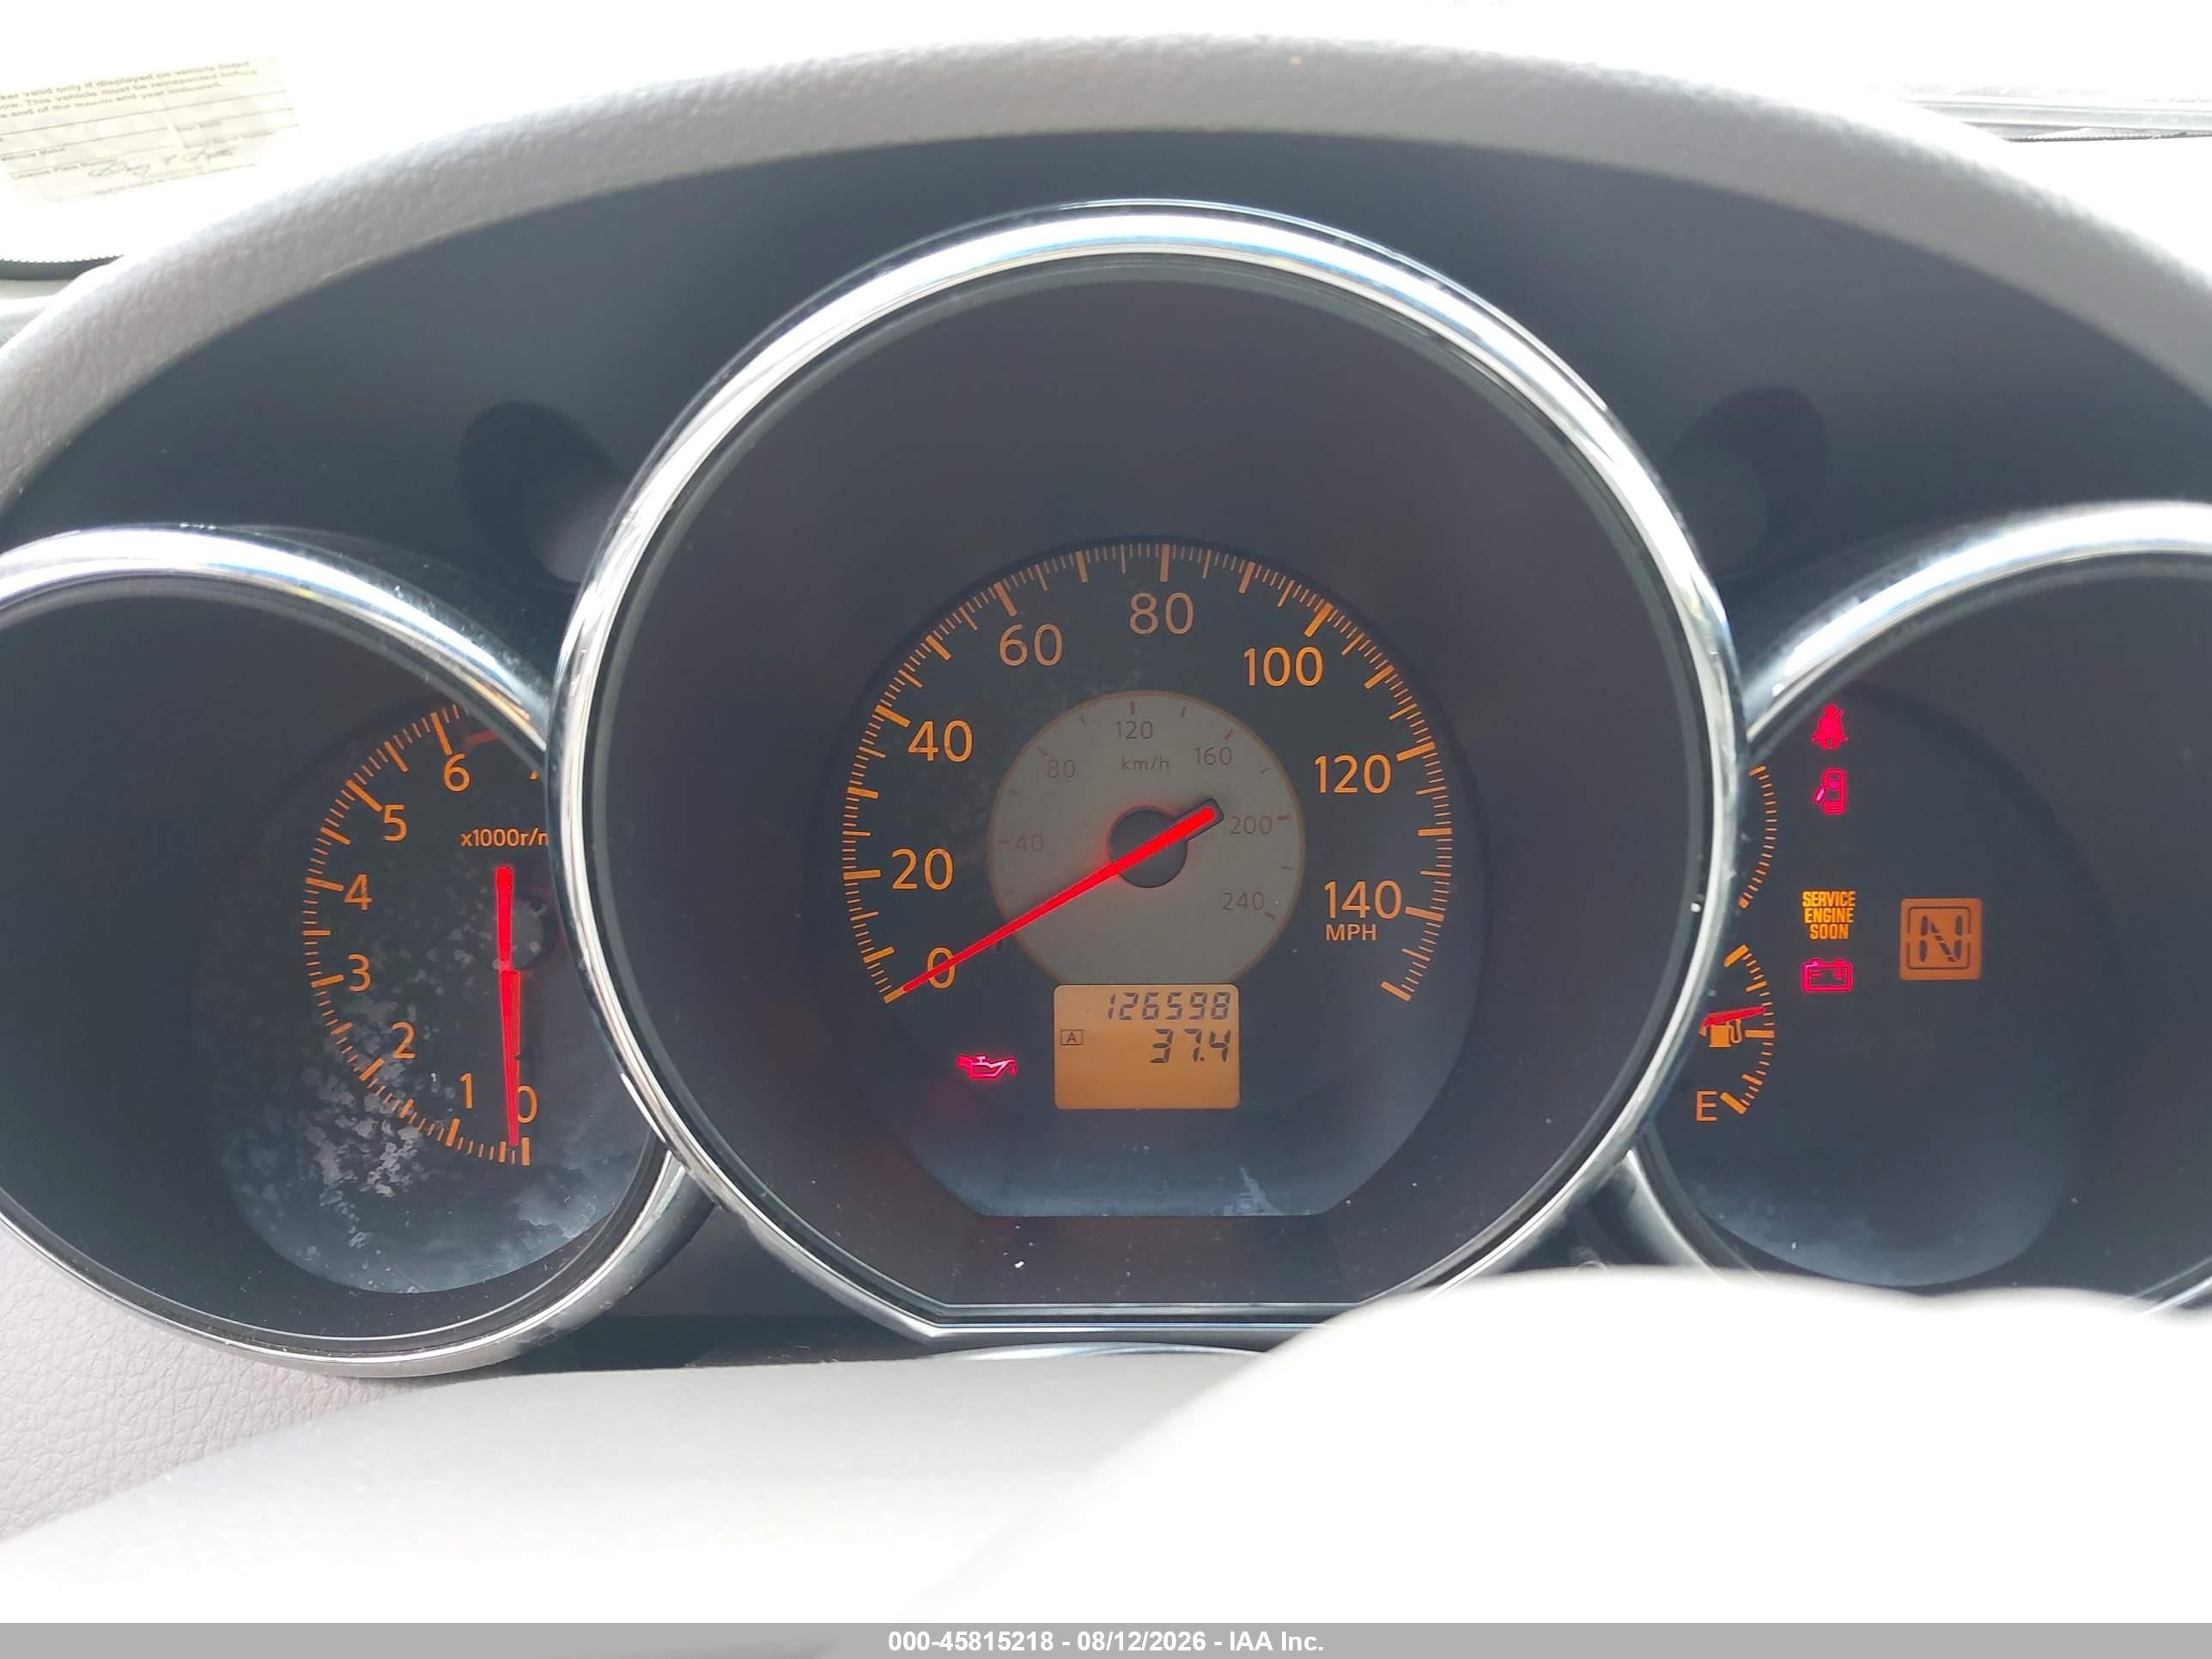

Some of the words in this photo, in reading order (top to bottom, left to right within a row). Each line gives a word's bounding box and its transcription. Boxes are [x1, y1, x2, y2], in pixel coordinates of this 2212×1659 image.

[23, 88, 52, 98] valid
[56, 84, 81, 93] only
[96, 73, 153, 88] displayed
[175, 65, 215, 76] vehicle
[25, 98, 52, 106] This
[56, 90, 97, 101] vehicle
[101, 86, 131, 95] must
[133, 81, 148, 91] be
[11, 108, 35, 118] end
[52, 102, 71, 111] the
[116, 93, 137, 102] and
[1129, 592, 1194, 635] 80
[999, 624, 1064, 667] 60
[1243, 647, 1324, 686] 100
[907, 720, 974, 763] 40
[1115, 720, 1154, 740] 120
[442, 752, 471, 792] 6
[1046, 758, 1076, 779] 80
[1121, 755, 1170, 772] km/h
[1194, 746, 1233, 766] 160
[1315, 754, 1392, 793] 120
[381, 804, 408, 842] 5
[1230, 815, 1273, 836] 200
[1015, 833, 1044, 853] 40
[892, 848, 954, 890] 20
[344, 873, 372, 911] 4
[1222, 891, 1265, 911] 240
[1325, 880, 1402, 920] 140
[1802, 890, 1856, 907] SERVICE
[1326, 924, 1377, 941] MPH
[1803, 908, 1855, 923] ENGINE
[1809, 924, 1849, 939] SOON
[1919, 915, 1964, 963] N
[349, 953, 372, 992] 3
[927, 947, 956, 989] 0
[1108, 992, 1231, 1020] 126598
[392, 1021, 416, 1060] 2
[1150, 1029, 1231, 1064] 37.4
[460, 1073, 473, 1109] 1
[1695, 1091, 1718, 1121] E
